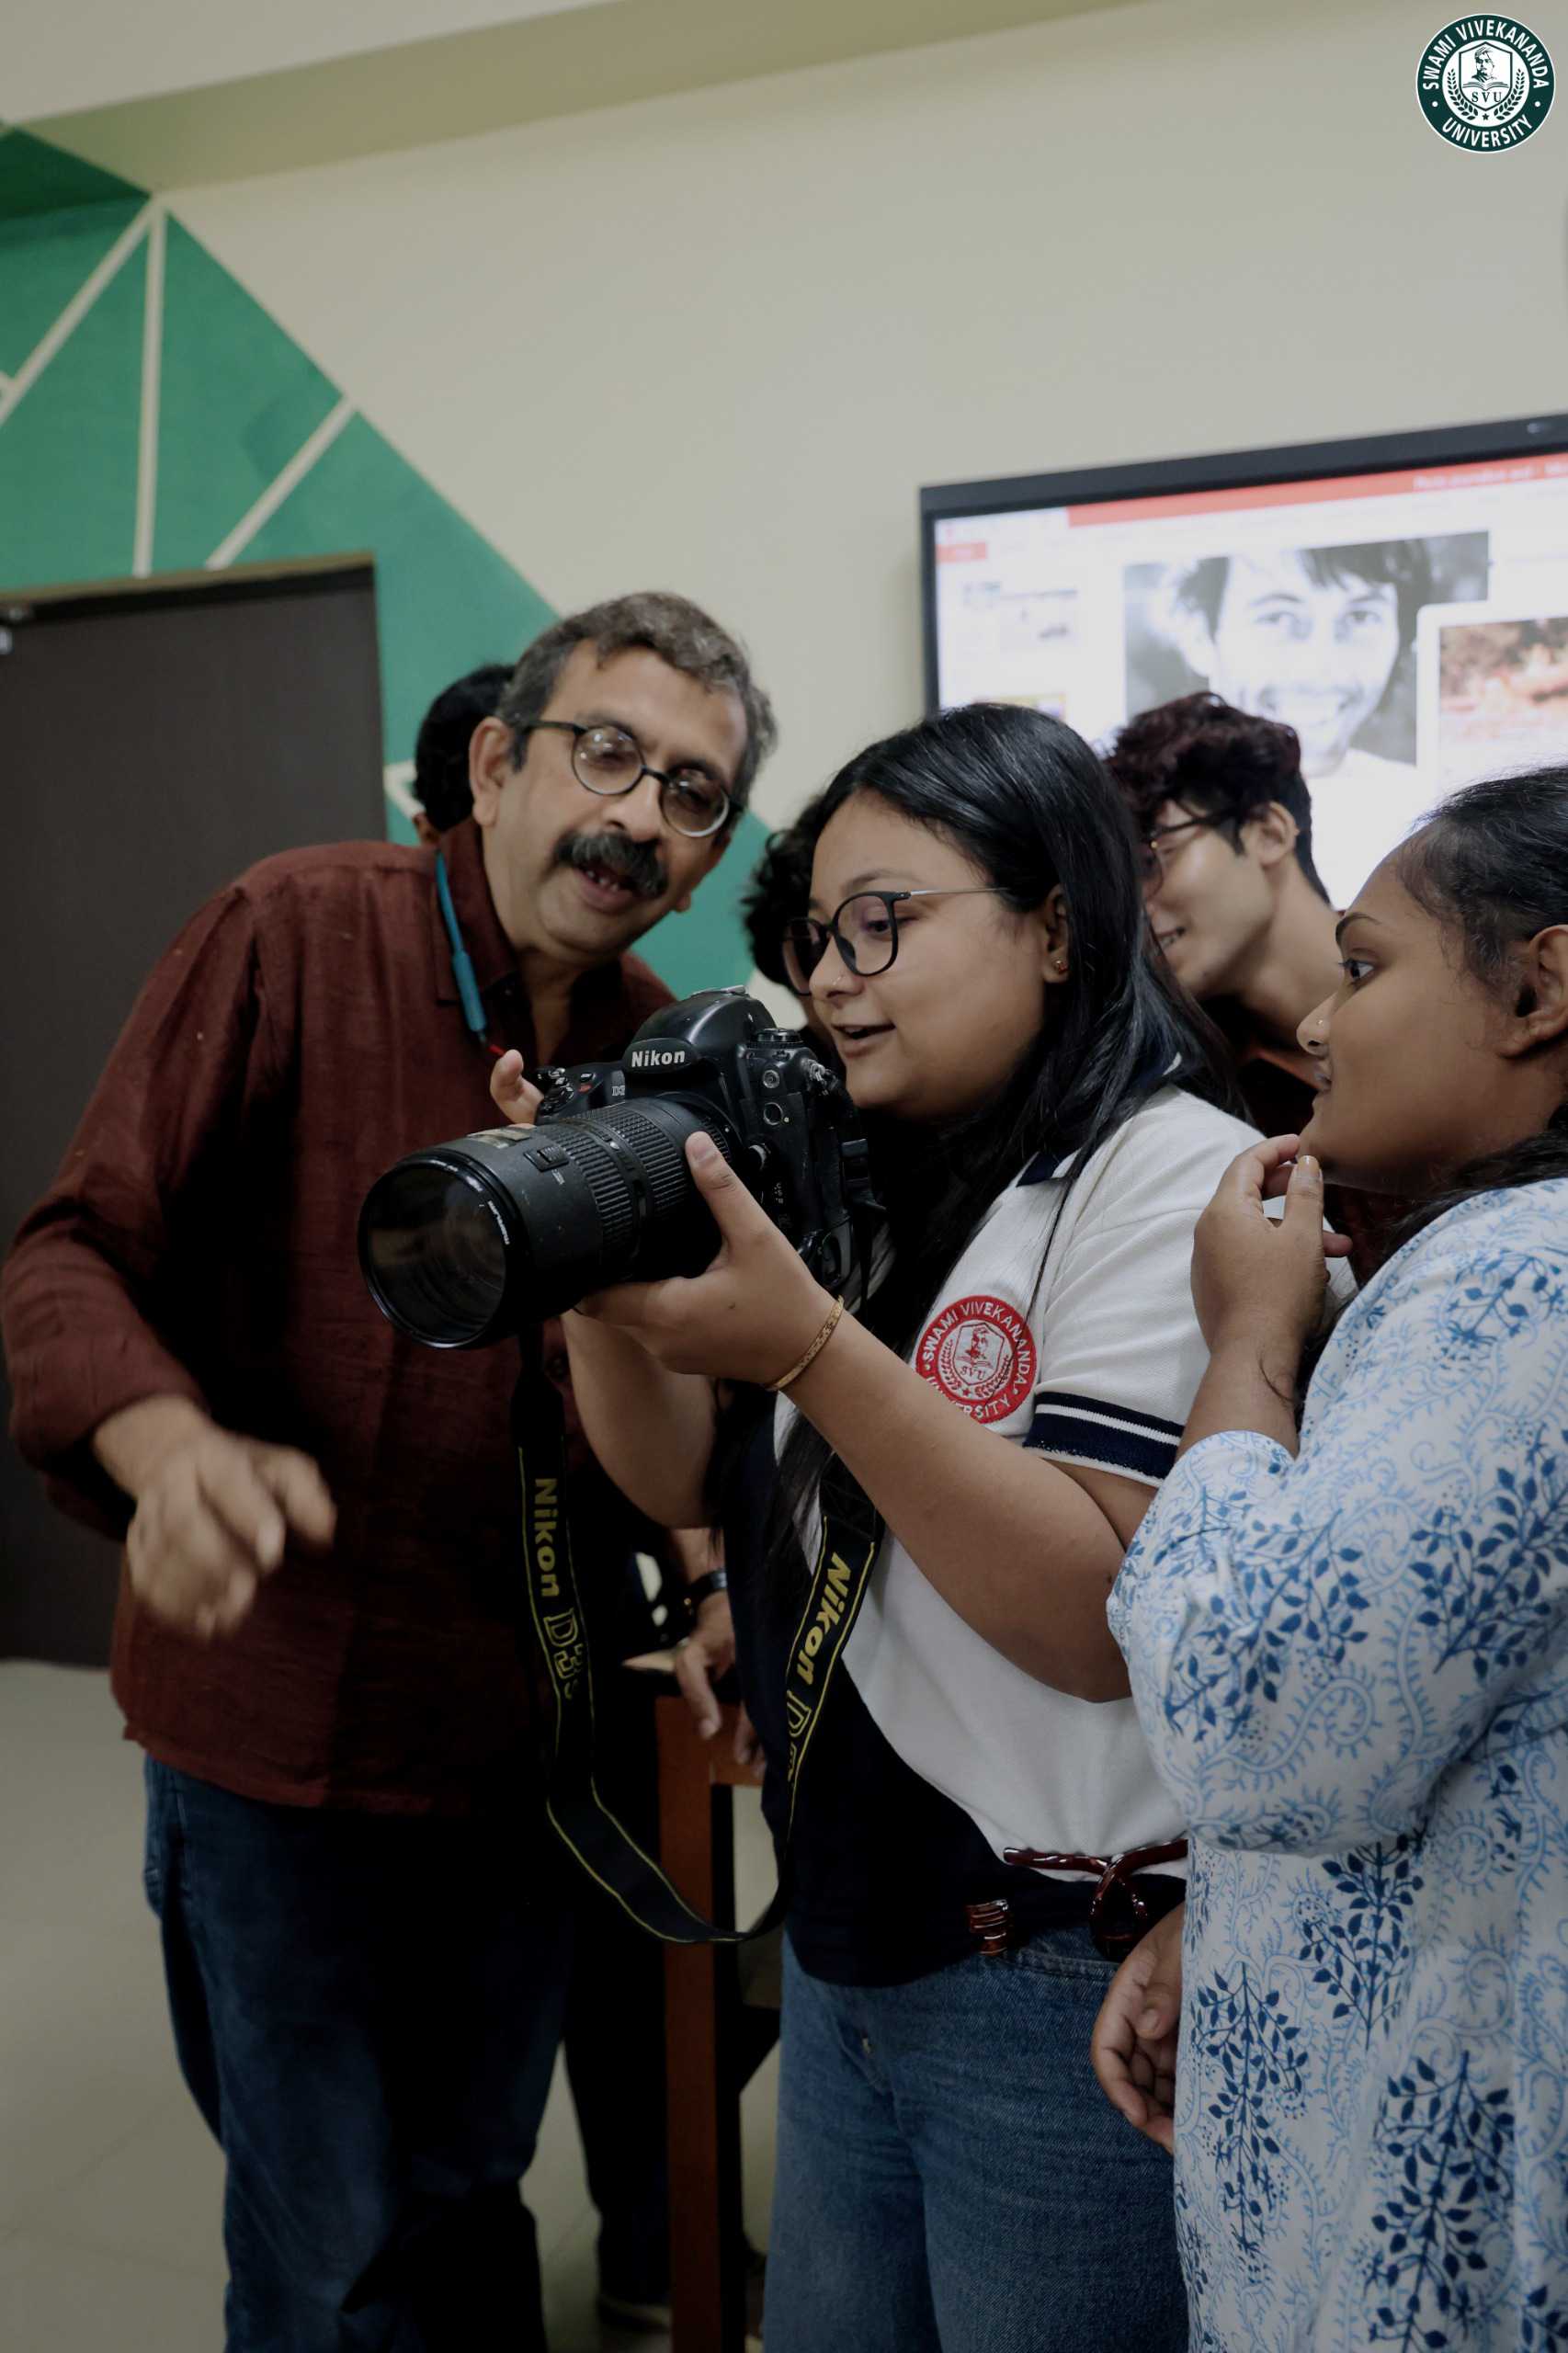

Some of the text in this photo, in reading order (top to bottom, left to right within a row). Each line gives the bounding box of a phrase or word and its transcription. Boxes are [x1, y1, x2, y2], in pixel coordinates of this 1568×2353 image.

[631, 1049, 686, 1067] Nikon
[923, 1302, 1030, 1385] SWAMI VIVEKANANDA
[534, 1478, 561, 1597] Nikon
[796, 1552, 853, 1686] Nikon
